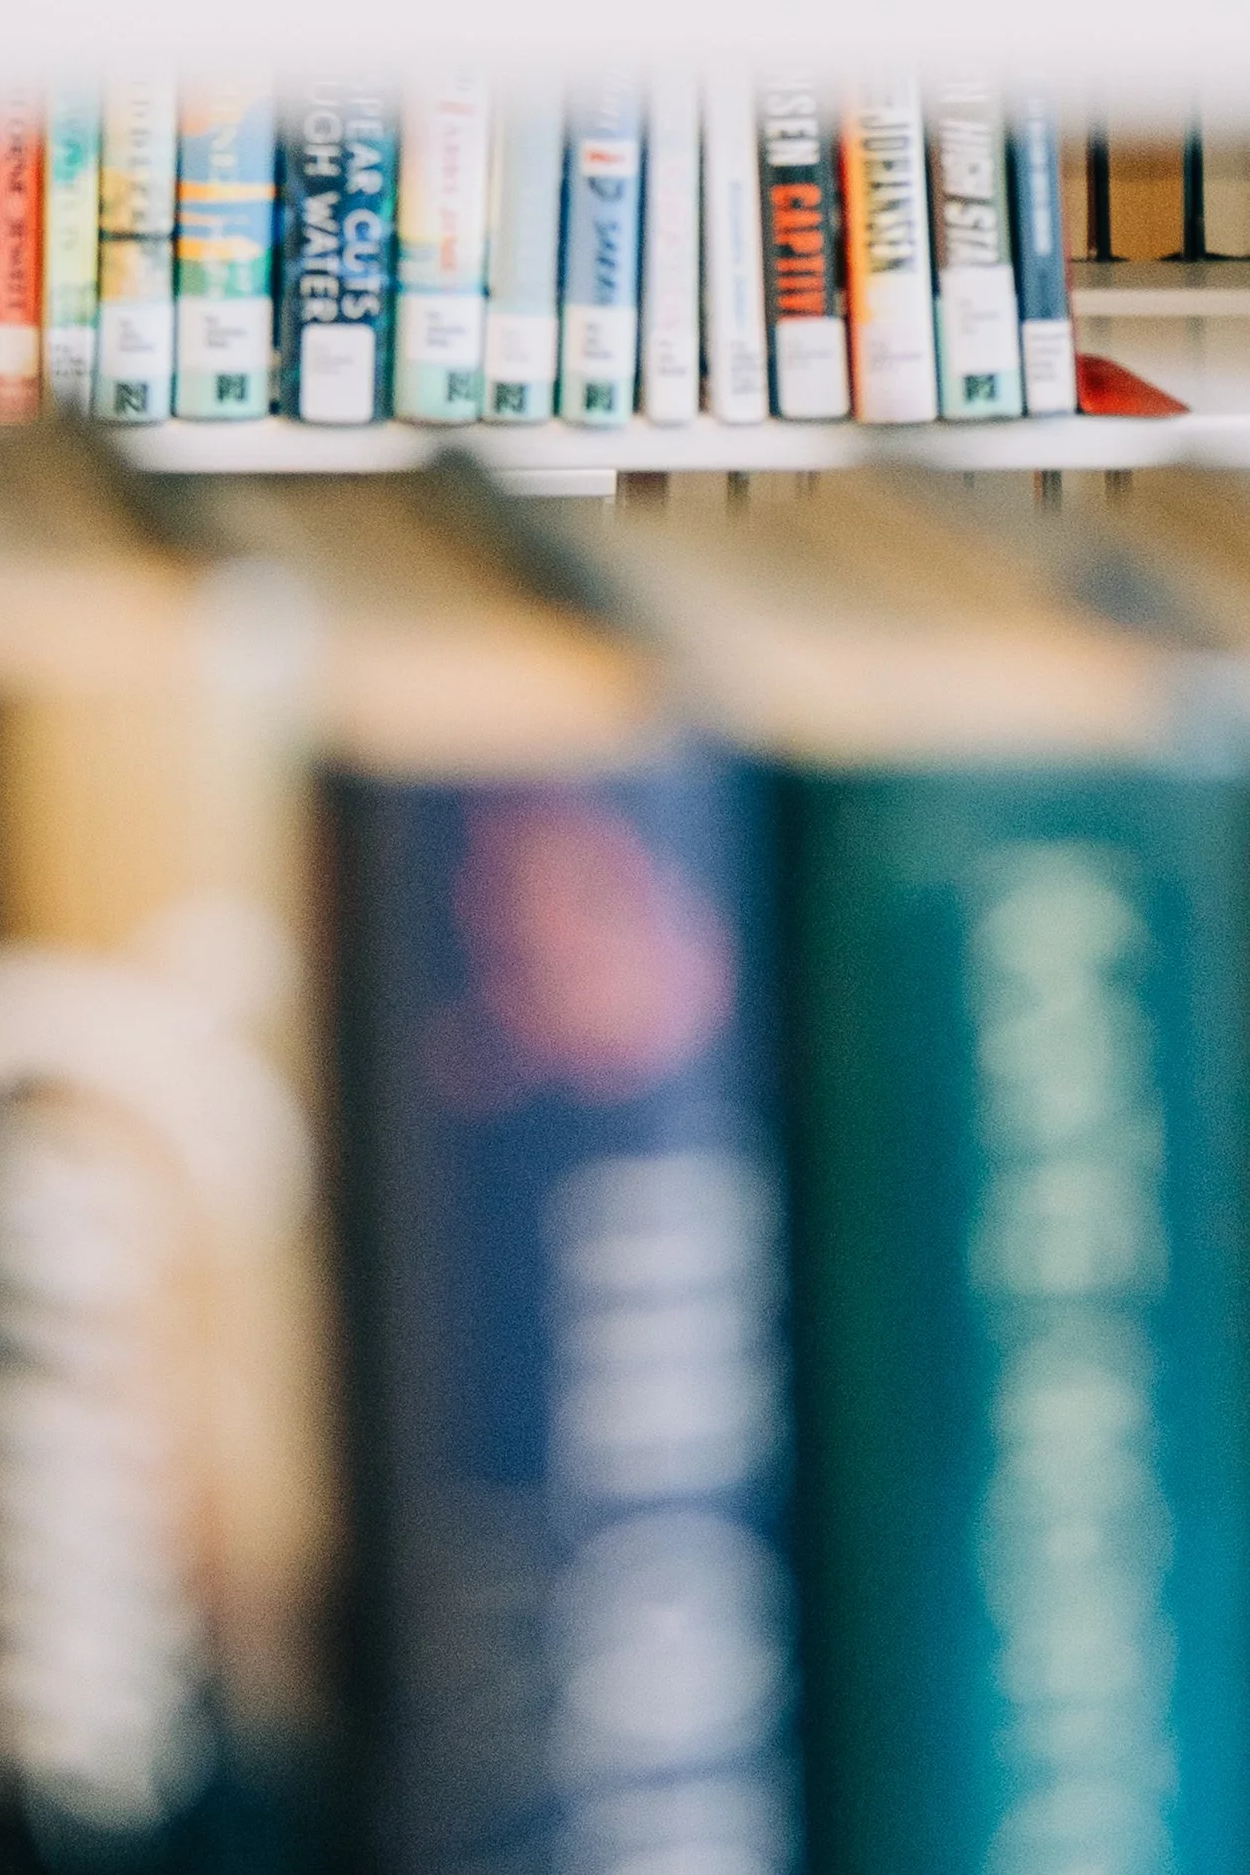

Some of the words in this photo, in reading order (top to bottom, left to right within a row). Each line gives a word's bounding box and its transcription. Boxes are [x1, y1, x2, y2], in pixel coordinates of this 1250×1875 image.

[346, 97, 384, 195] PEAR
[764, 91, 820, 166] SEN
[299, 191, 340, 323] WATER
[341, 208, 383, 321] CUTS
[771, 182, 826, 317] CAPTIV
[944, 201, 999, 268] STA
